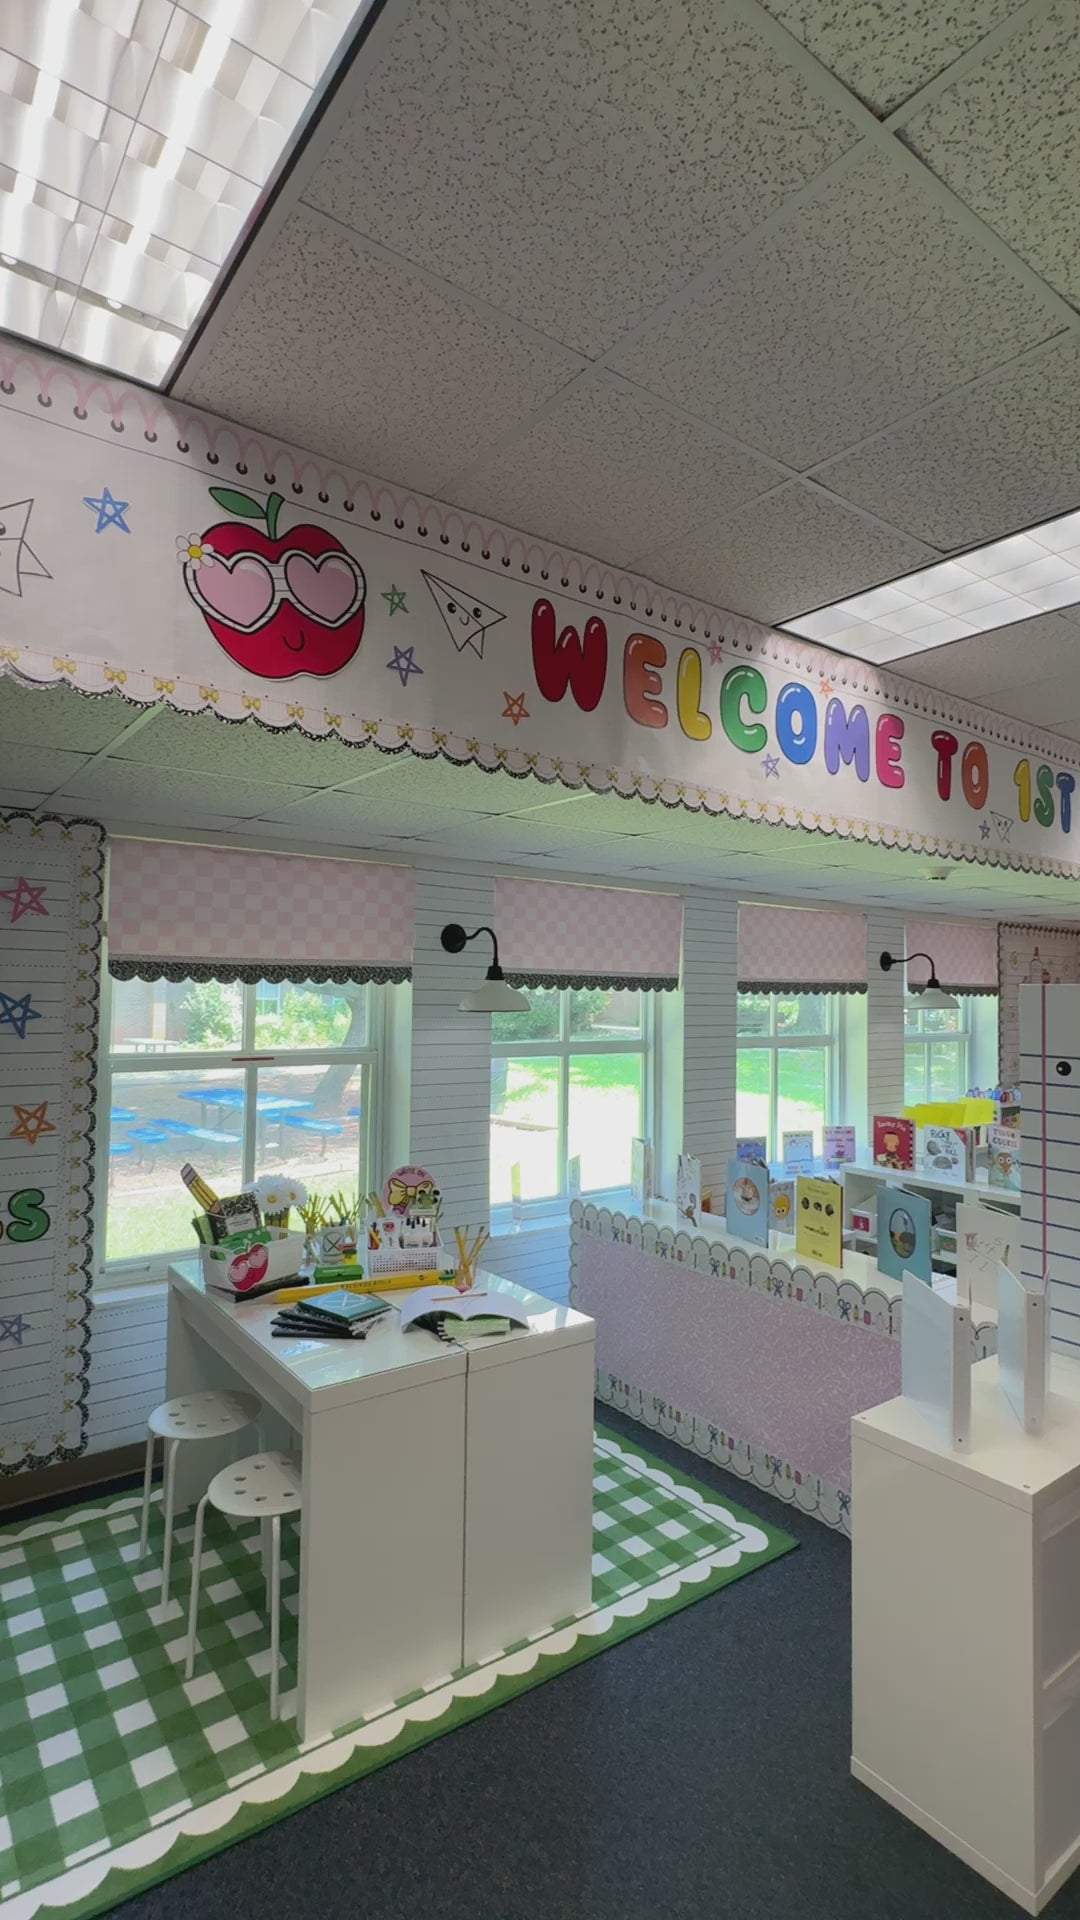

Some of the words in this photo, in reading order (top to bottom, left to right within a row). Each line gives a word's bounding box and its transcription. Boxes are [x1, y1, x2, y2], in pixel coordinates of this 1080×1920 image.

[530, 598, 905, 788] WELCOME
[930, 730, 989, 809] TO
[1013, 758, 1076, 833] 1ST
[0, 1188, 50, 1242] S
